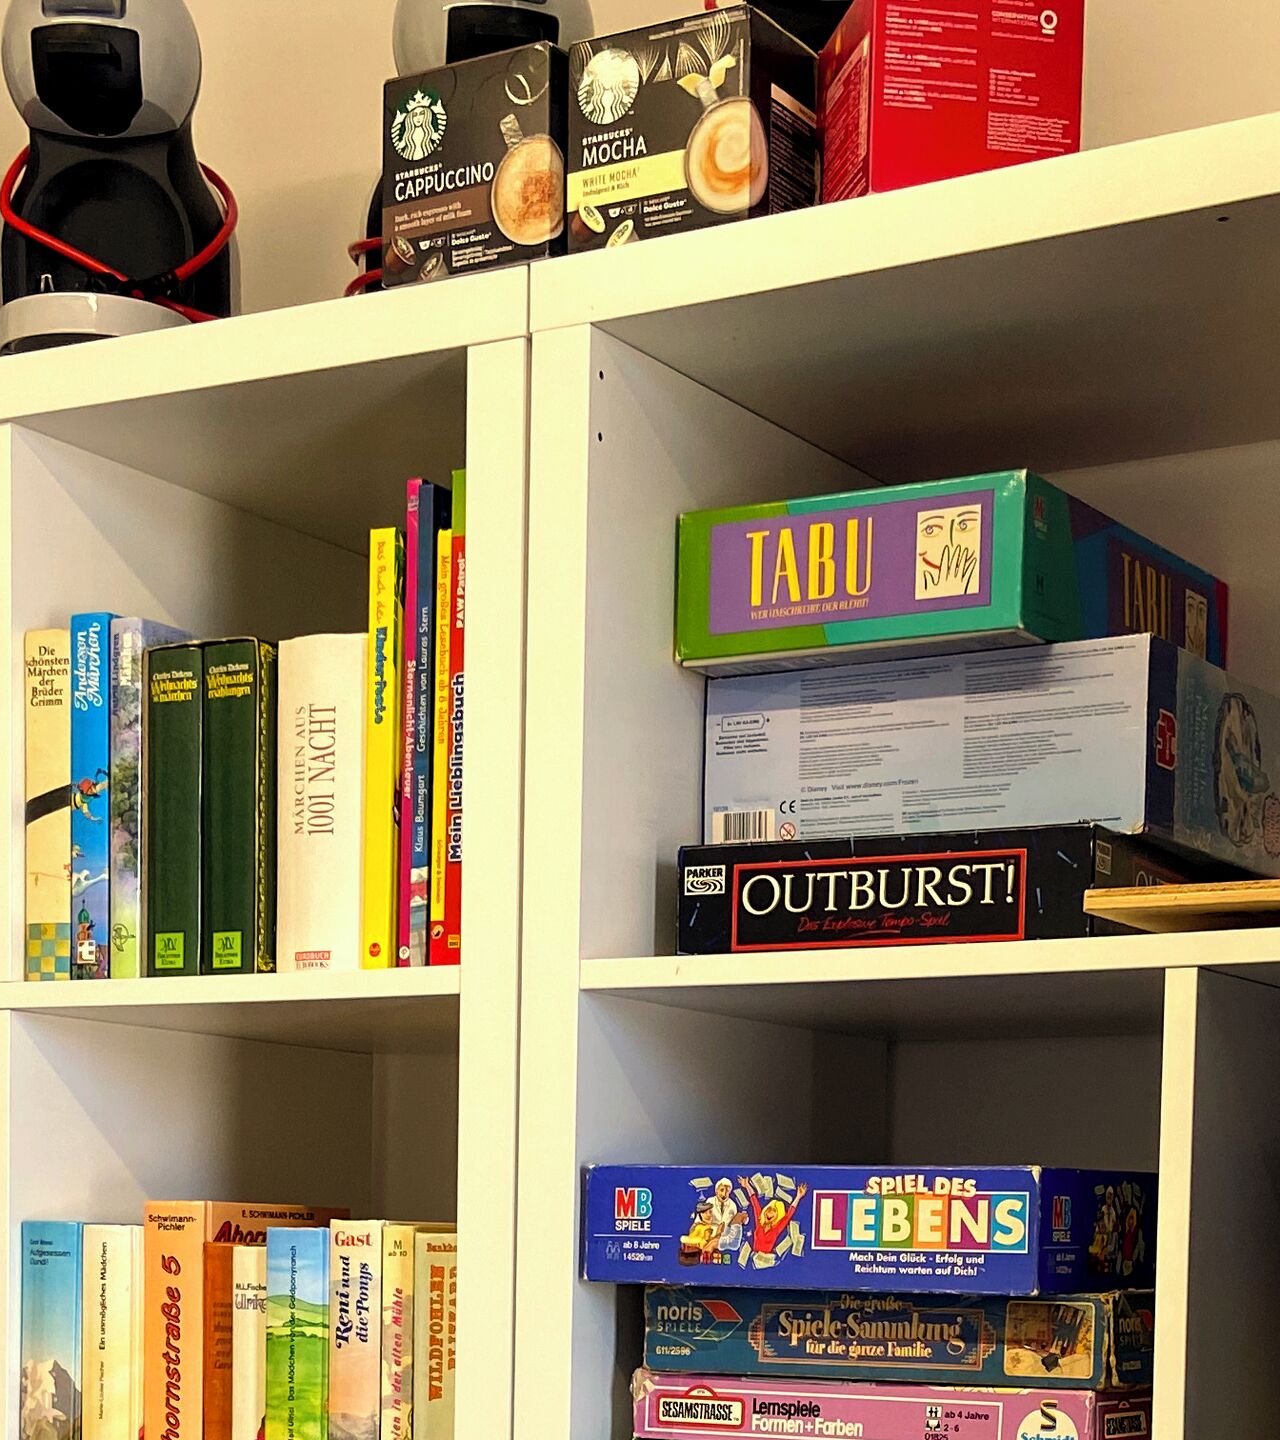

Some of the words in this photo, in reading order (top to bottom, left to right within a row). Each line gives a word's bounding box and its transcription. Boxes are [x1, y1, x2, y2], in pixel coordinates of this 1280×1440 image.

[582, 128, 633, 145] STARBUCKS
[582, 136, 647, 167] MOCHA
[395, 163, 442, 181] STARBUCKS
[395, 162, 494, 201] CAPPUCCINO
[746, 515, 873, 607] TABU
[38, 646, 55, 656] Die
[28, 666, 68, 677] Märchen
[31, 697, 63, 707] Grimm
[32, 687, 63, 697] Brüder
[308, 703, 338, 789] NACHT
[448, 672, 465, 813] Lieblingsbuch
[307, 793, 334, 836] 1001
[448, 817, 464, 864] Mein
[687, 867, 723, 879] PARKER
[742, 864, 1015, 915] OUTBURST!
[866, 1176, 932, 1197] SPIEL
[935, 1178, 978, 1198] DES
[615, 1188, 653, 1220] MB
[615, 1219, 651, 1233] SPIELE
[818, 1197, 1026, 1248] LEBENS
[334, 1230, 373, 1247] Gast
[167, 1254, 182, 1275] 5
[656, 1303, 703, 1323] noris
[428, 1265, 445, 1402] WILDFOHLEN
[661, 1399, 734, 1422] SESAMSTRASSE
[752, 1398, 820, 1418] Lernspiele
[751, 1415, 863, 1438] Formen+Farben
